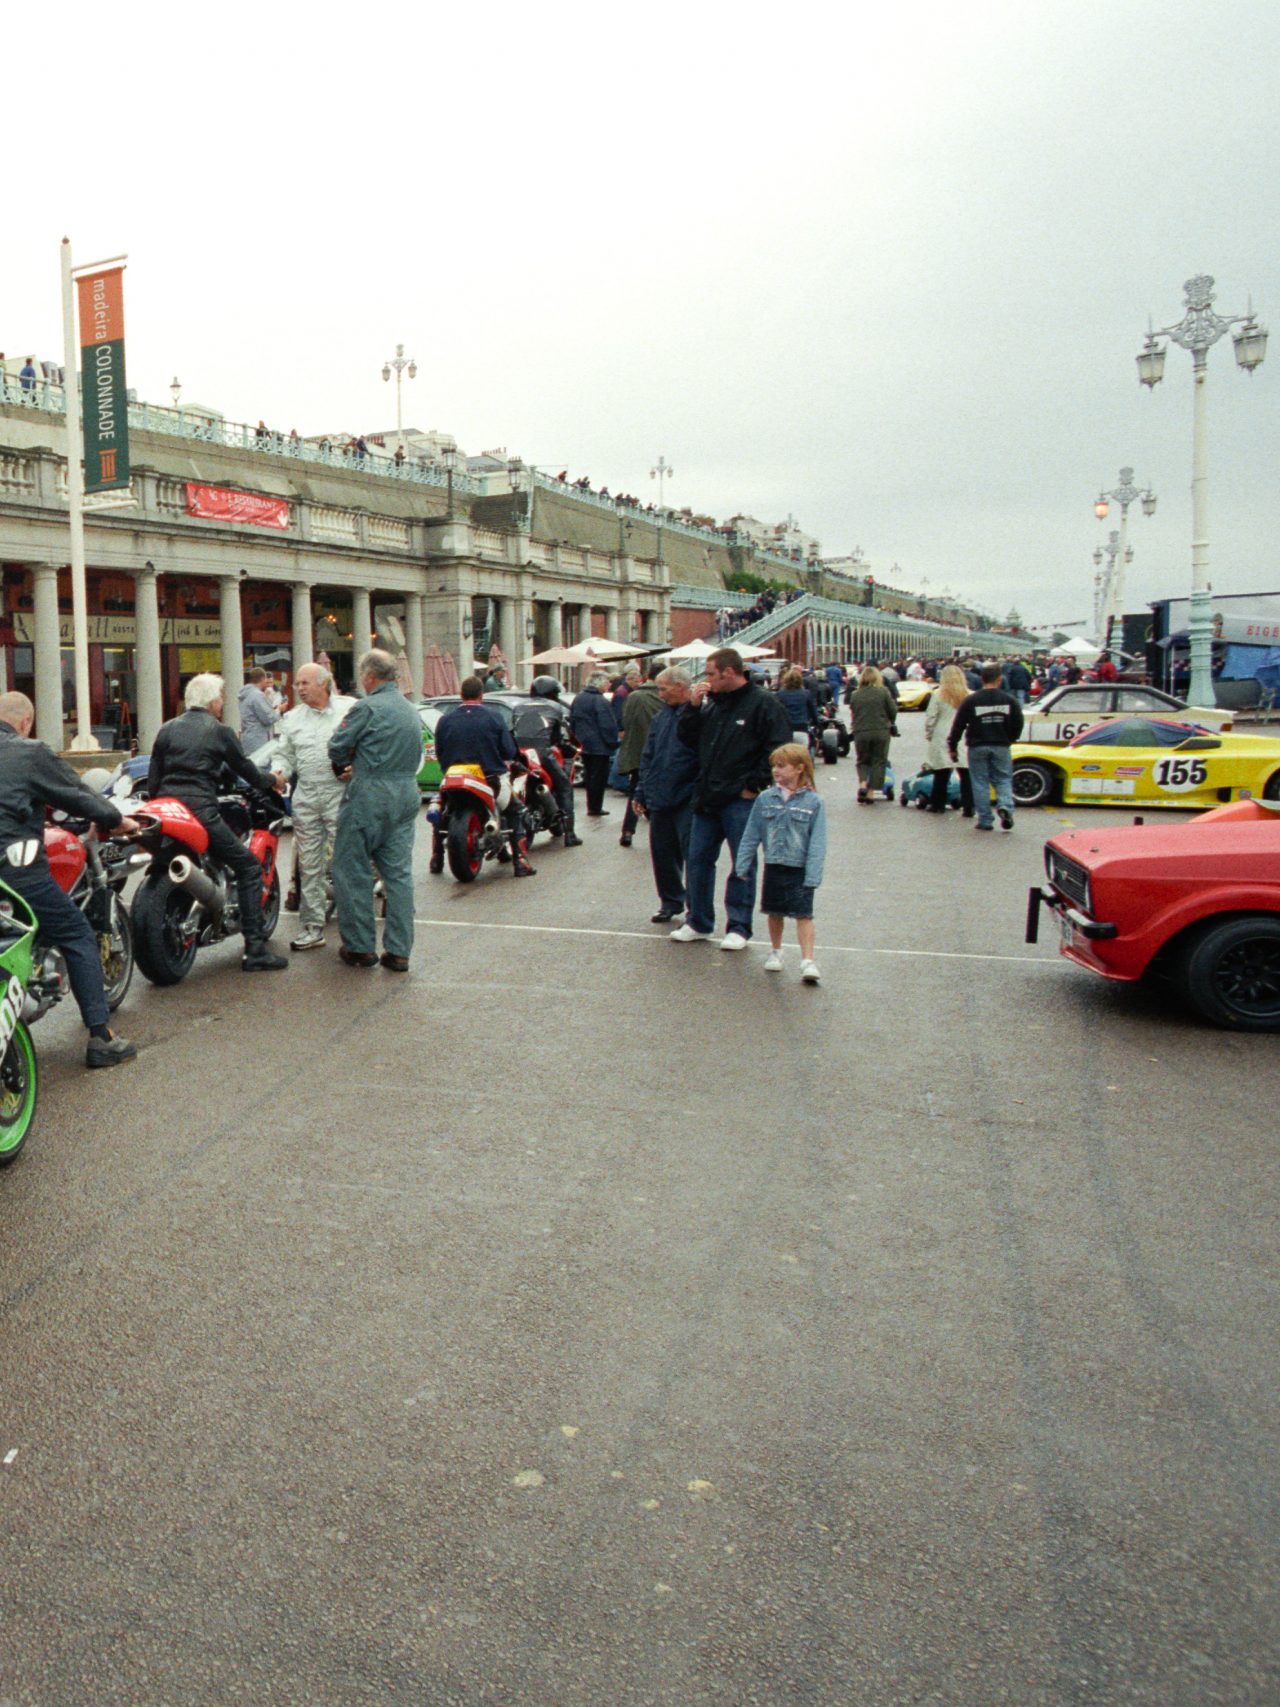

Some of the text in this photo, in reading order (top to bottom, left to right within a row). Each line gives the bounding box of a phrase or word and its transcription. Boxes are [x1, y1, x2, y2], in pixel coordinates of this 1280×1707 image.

[93, 279, 115, 441] madeira COLONNADE
[1157, 758, 1209, 786] 155
